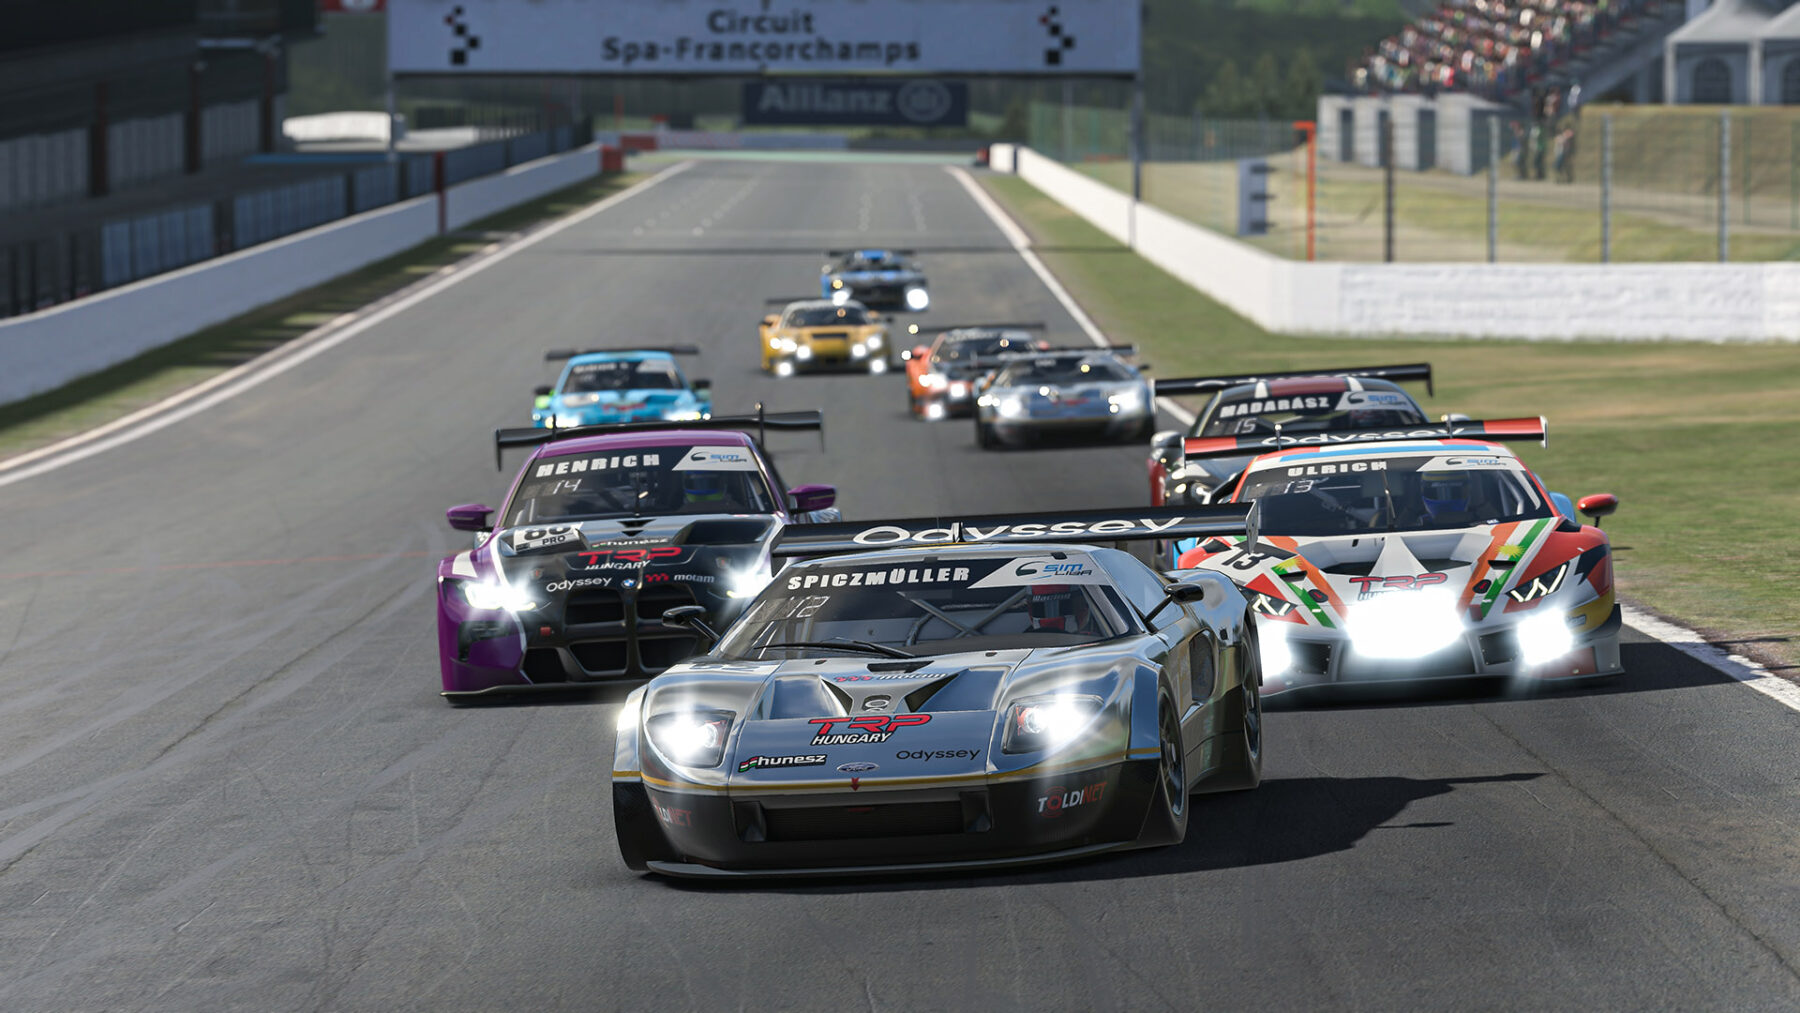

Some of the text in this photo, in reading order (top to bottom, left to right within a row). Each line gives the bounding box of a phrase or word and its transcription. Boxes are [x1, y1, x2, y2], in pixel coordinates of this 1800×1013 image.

[707, 9, 815, 34] Circuit
[602, 36, 921, 65] Spa-Francorchamps
[758, 85, 890, 113] Allianz
[535, 454, 660, 478] HENRICH
[1287, 461, 1388, 477] ULRICH
[541, 534, 566, 545] PRO
[853, 516, 1185, 545] Odyssey
[578, 546, 682, 565] TRP
[584, 560, 650, 571] HUNGARY
[546, 577, 612, 592] Odyssey
[673, 574, 715, 583] motam
[787, 567, 970, 590] SPICZMÜLLER
[1349, 572, 1448, 593] TRP
[808, 714, 932, 735] TRP
[810, 732, 894, 746] HUNGARY
[757, 754, 826, 770] hunesz
[896, 749, 980, 762] Odyssey
[1038, 781, 1108, 813] TOLDINET
